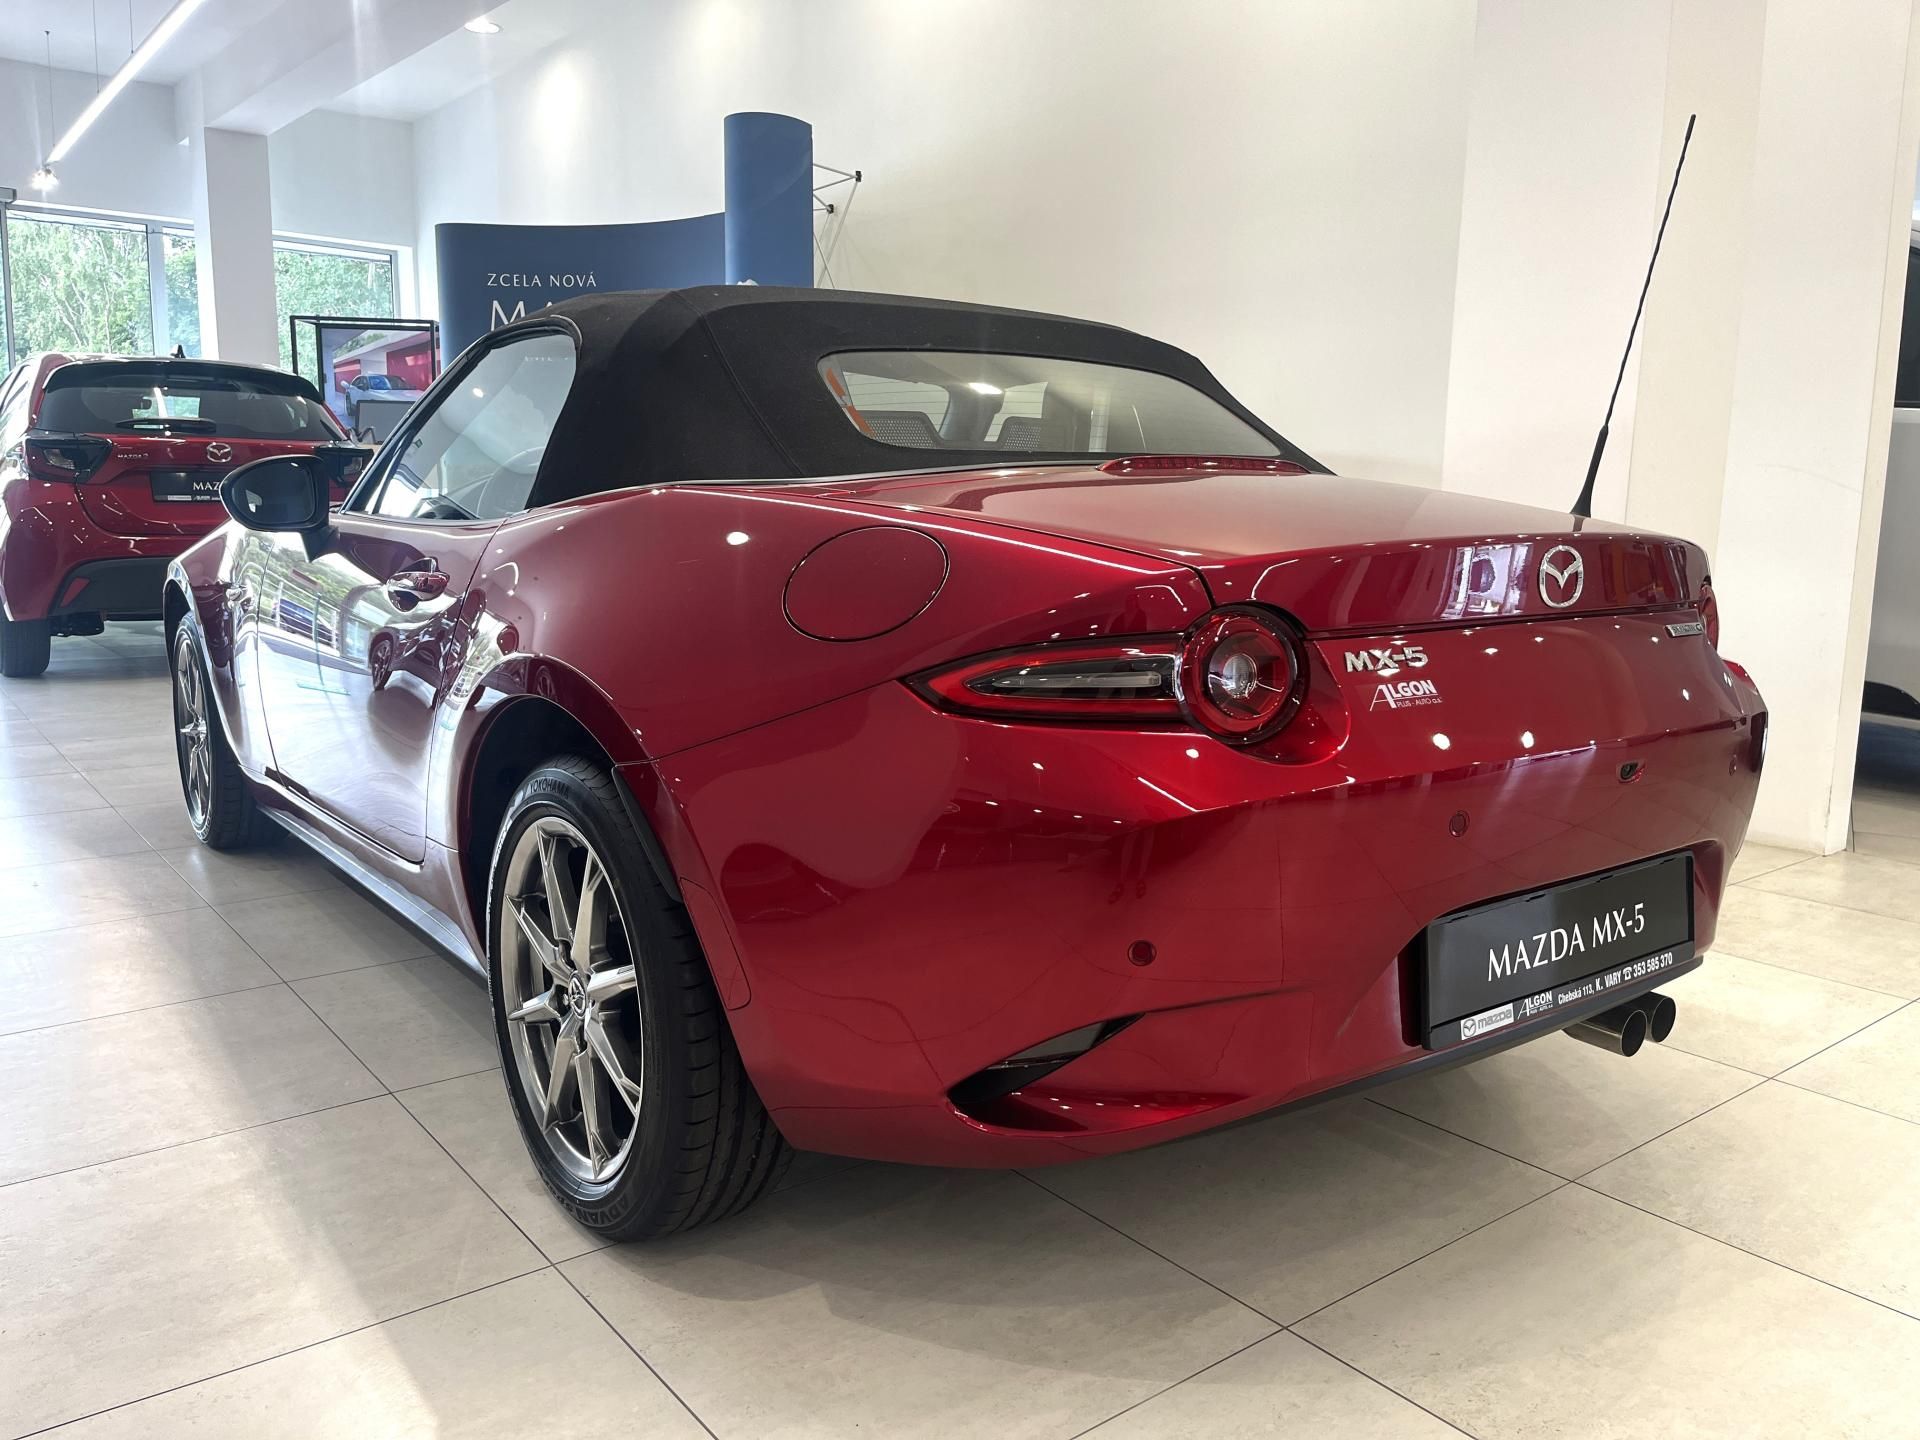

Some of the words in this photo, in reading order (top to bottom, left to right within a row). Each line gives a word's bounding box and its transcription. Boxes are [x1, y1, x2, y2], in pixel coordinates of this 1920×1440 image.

[487, 273, 542, 287] ZCELA
[549, 271, 597, 288] NOVÁ
[490, 300, 553, 332] M
[1344, 646, 1429, 673] MX-5
[1369, 680, 1438, 711] ALGON
[1415, 697, 1432, 705] AUTO
[530, 777, 570, 799] YOKOHAMA
[1488, 922, 1586, 982] MAZDA
[1592, 902, 1645, 949] MX-5
[1558, 986, 1582, 1005] Chebská
[1582, 983, 1595, 996] 113,
[1595, 977, 1604, 992] K.
[1604, 969, 1622, 988] VARY
[1633, 960, 1646, 977] 353
[1660, 951, 1673, 969] 370
[1478, 1008, 1513, 1030] mazda
[1518, 990, 1553, 1020] ALGON
